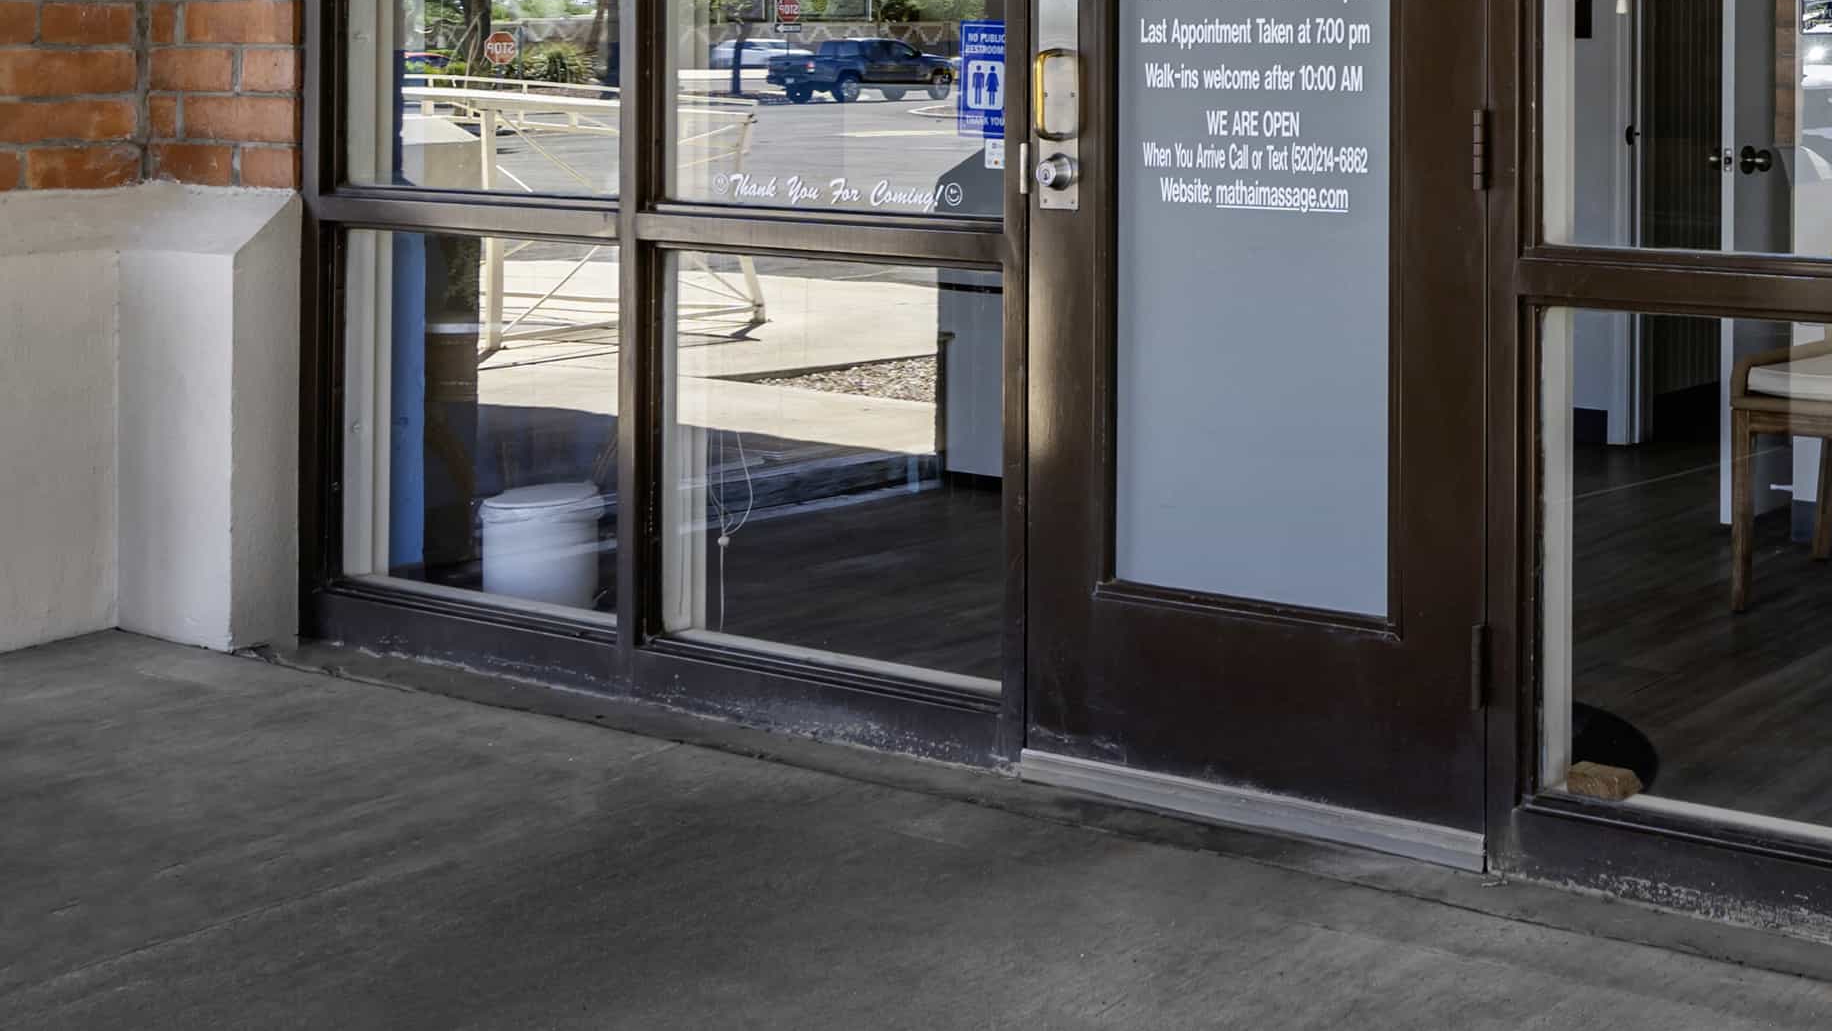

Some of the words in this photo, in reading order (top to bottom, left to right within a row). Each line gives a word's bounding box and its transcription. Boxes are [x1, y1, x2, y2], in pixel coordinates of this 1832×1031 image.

[968, 33, 979, 42] NO
[1141, 18, 1167, 43] Last
[1171, 18, 1251, 49] Appointment
[1256, 18, 1293, 43] Taken
[1298, 20, 1311, 43] at
[1316, 18, 1344, 43] 7:00
[1349, 24, 1370, 50] pm
[1145, 63, 1199, 89] Walk-ins
[1203, 64, 1260, 90] welcome
[1264, 65, 1295, 90] after
[1299, 65, 1336, 91] 10:00
[1341, 66, 1362, 91] AM
[1206, 110, 1228, 135] WE
[1232, 111, 1259, 136] ARE
[1263, 111, 1299, 137] OPEN
[1143, 142, 1171, 167] When
[1174, 143, 1193, 168] You
[1196, 143, 1225, 168] Arrive
[1229, 143, 1248, 170] Call
[1252, 151, 1263, 170] or
[1266, 145, 1288, 170] Text
[1292, 143, 1368, 174] (520)214-6862
[729, 173, 777, 198] Thank
[787, 176, 819, 205] You
[829, 177, 861, 205] For
[870, 179, 944, 213] Coming!
[1160, 177, 1212, 203] Website:
[1216, 180, 1348, 213] mathaimassage.com
